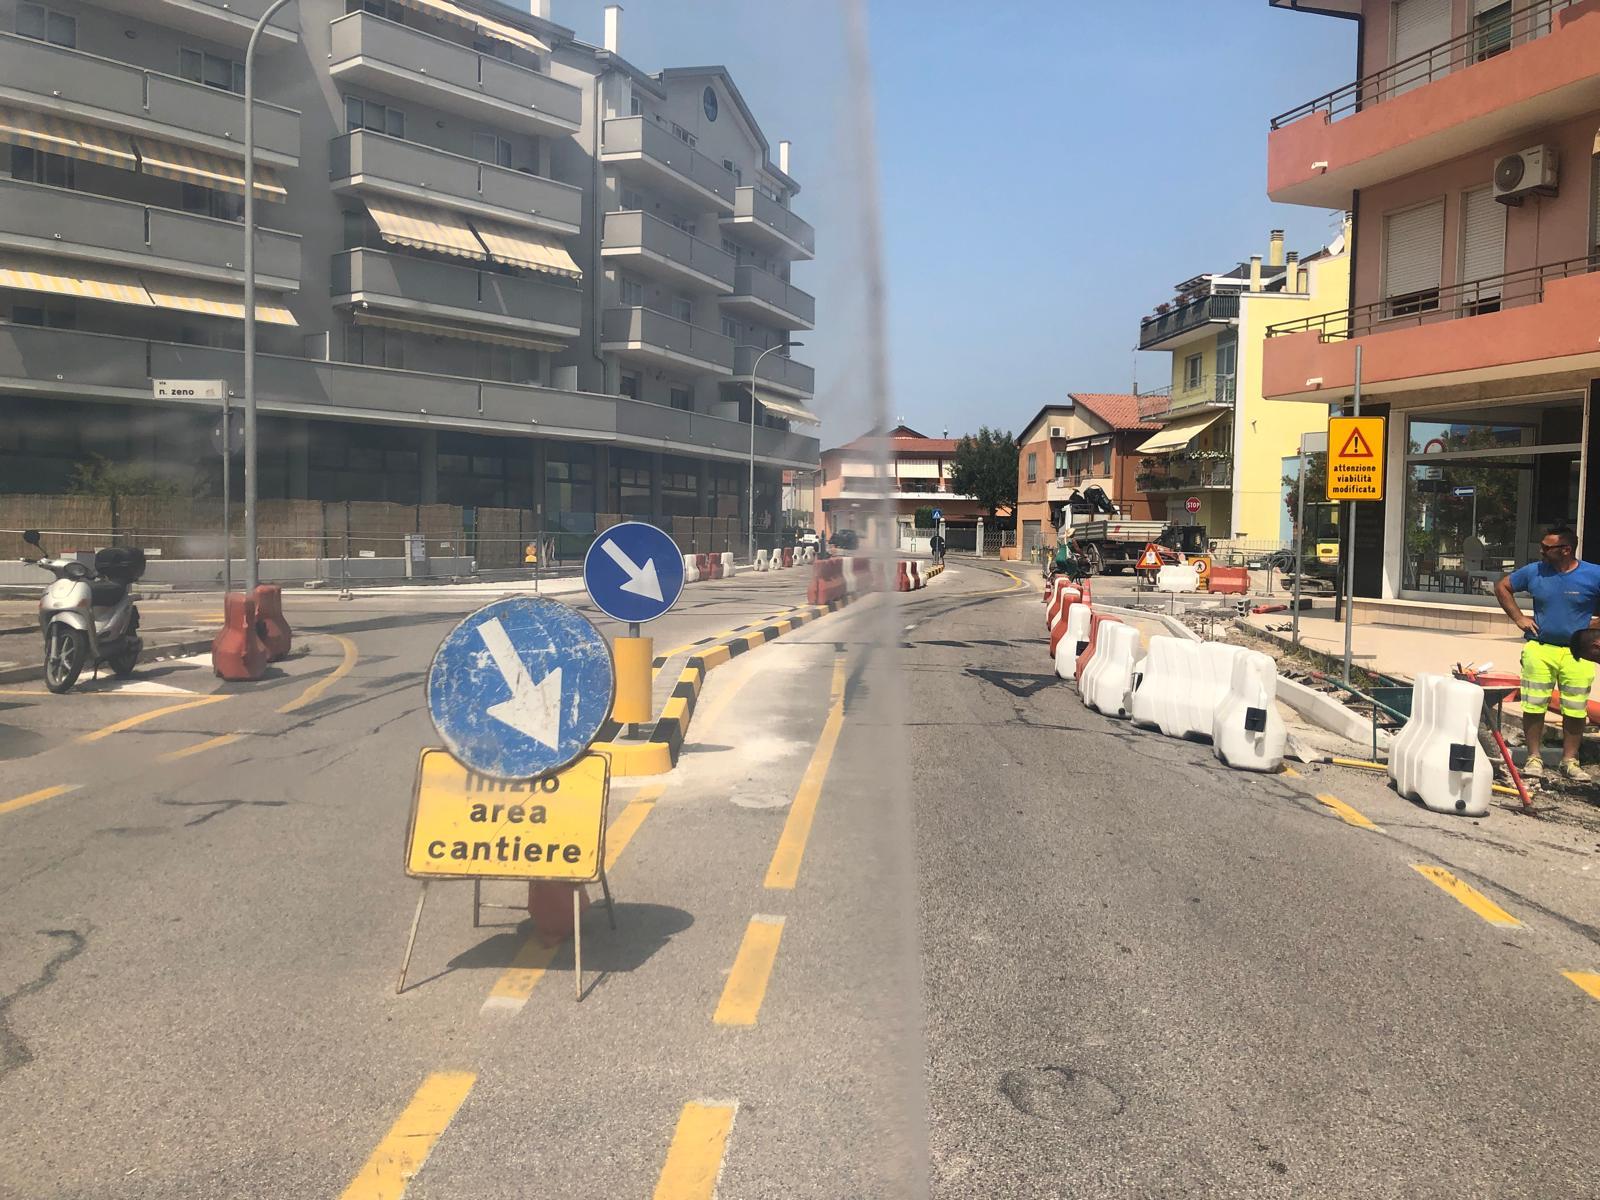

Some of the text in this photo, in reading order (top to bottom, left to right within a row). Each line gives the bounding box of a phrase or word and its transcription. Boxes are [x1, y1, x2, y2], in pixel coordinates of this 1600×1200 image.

[1333, 464, 1376, 472] attenzione
[1337, 474, 1372, 482] viabilità
[1332, 485, 1376, 493] modificata
[470, 803, 547, 824] area
[428, 836, 581, 863] cantiere
